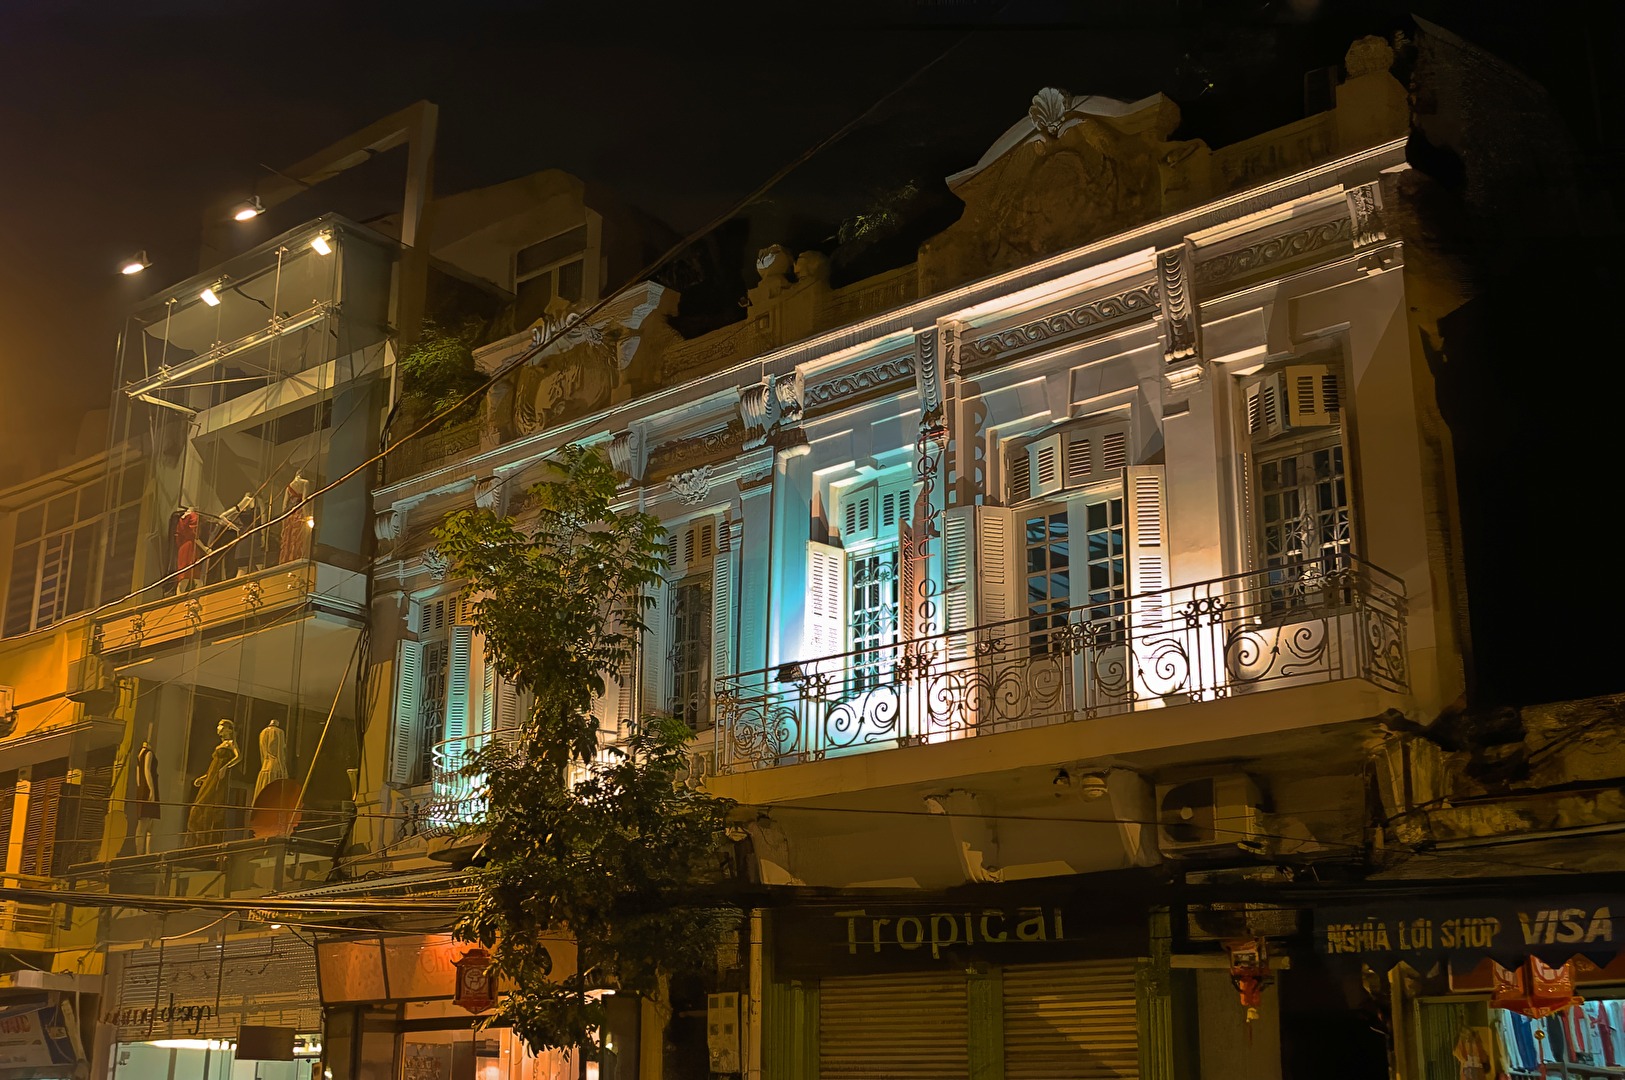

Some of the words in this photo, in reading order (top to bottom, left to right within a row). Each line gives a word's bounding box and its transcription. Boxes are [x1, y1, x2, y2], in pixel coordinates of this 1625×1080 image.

[834, 906, 1064, 959] Tropical
[1440, 916, 1501, 949] SHOP
[1518, 906, 1613, 944] VISA
